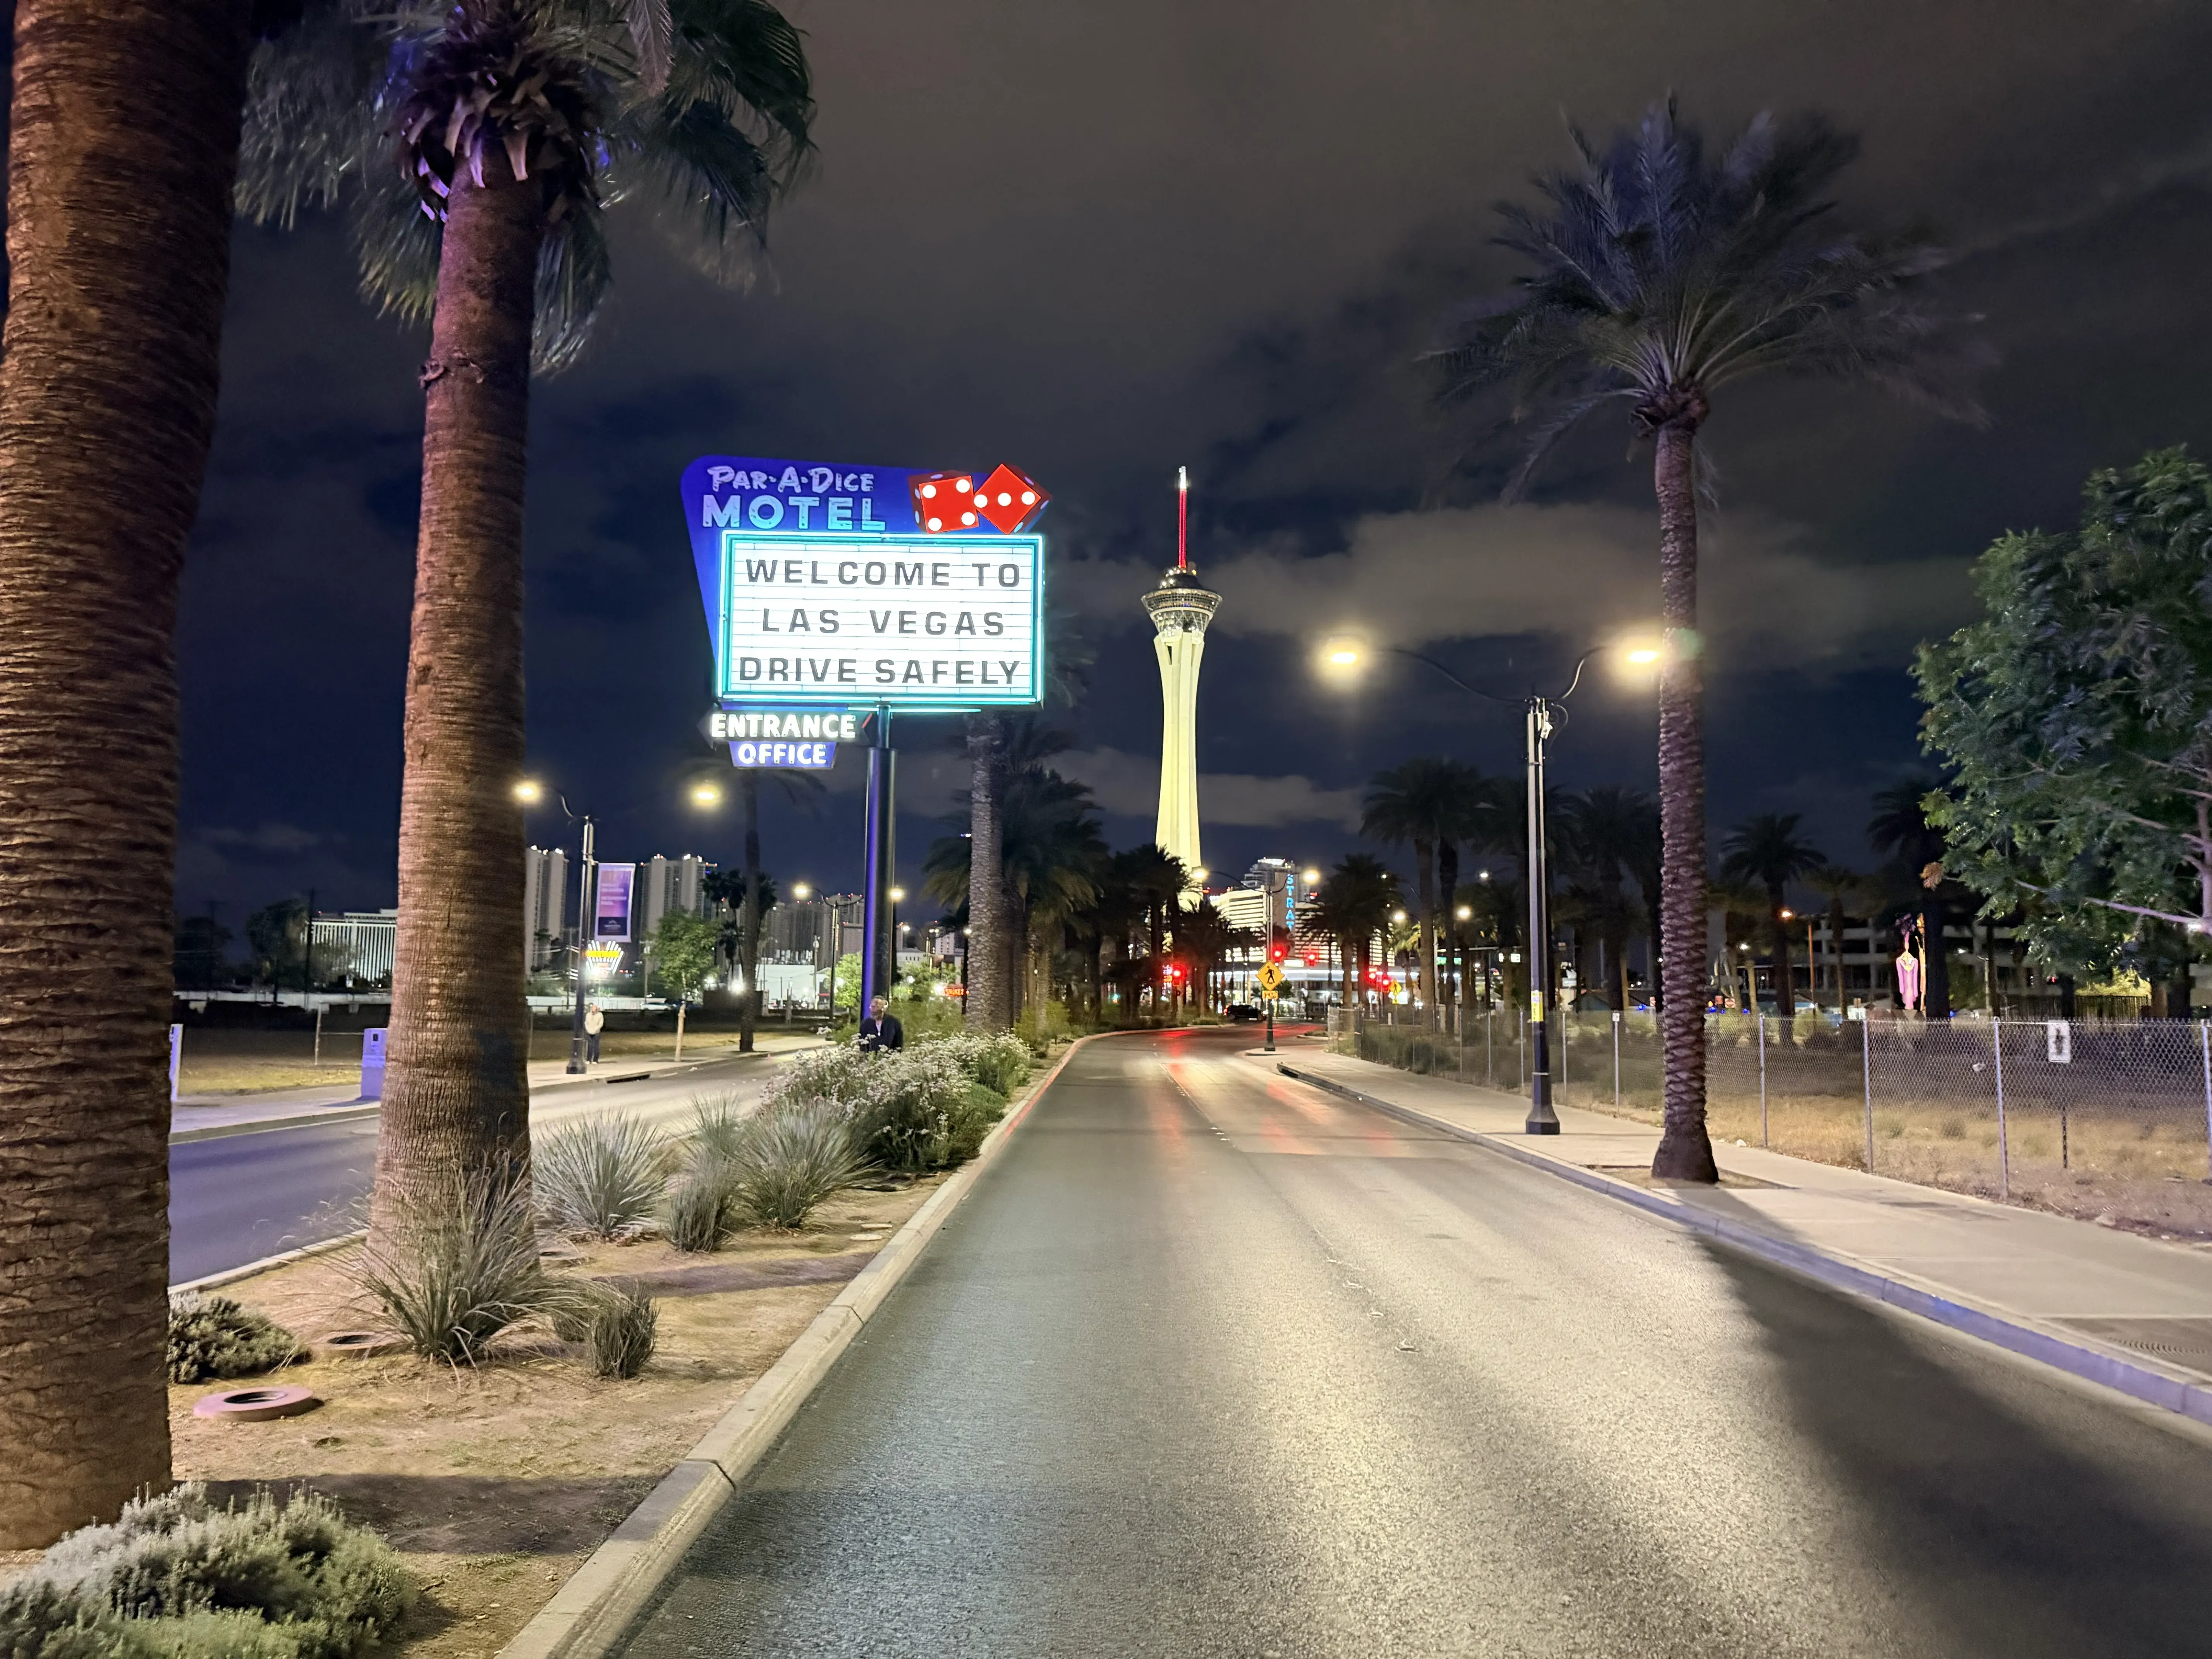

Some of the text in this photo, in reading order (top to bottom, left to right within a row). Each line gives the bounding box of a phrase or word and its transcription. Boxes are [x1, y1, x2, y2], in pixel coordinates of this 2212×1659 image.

[702, 495, 885, 531] MOTEL
[746, 559, 1020, 587] WELCOME TO
[763, 608, 1004, 635] LAS VEGAS
[740, 657, 1020, 684] DRIVE SAFELY
[711, 714, 856, 738] ENTRANCE
[738, 743, 826, 764] OFFICE
[1286, 874, 1295, 932] STRAT
